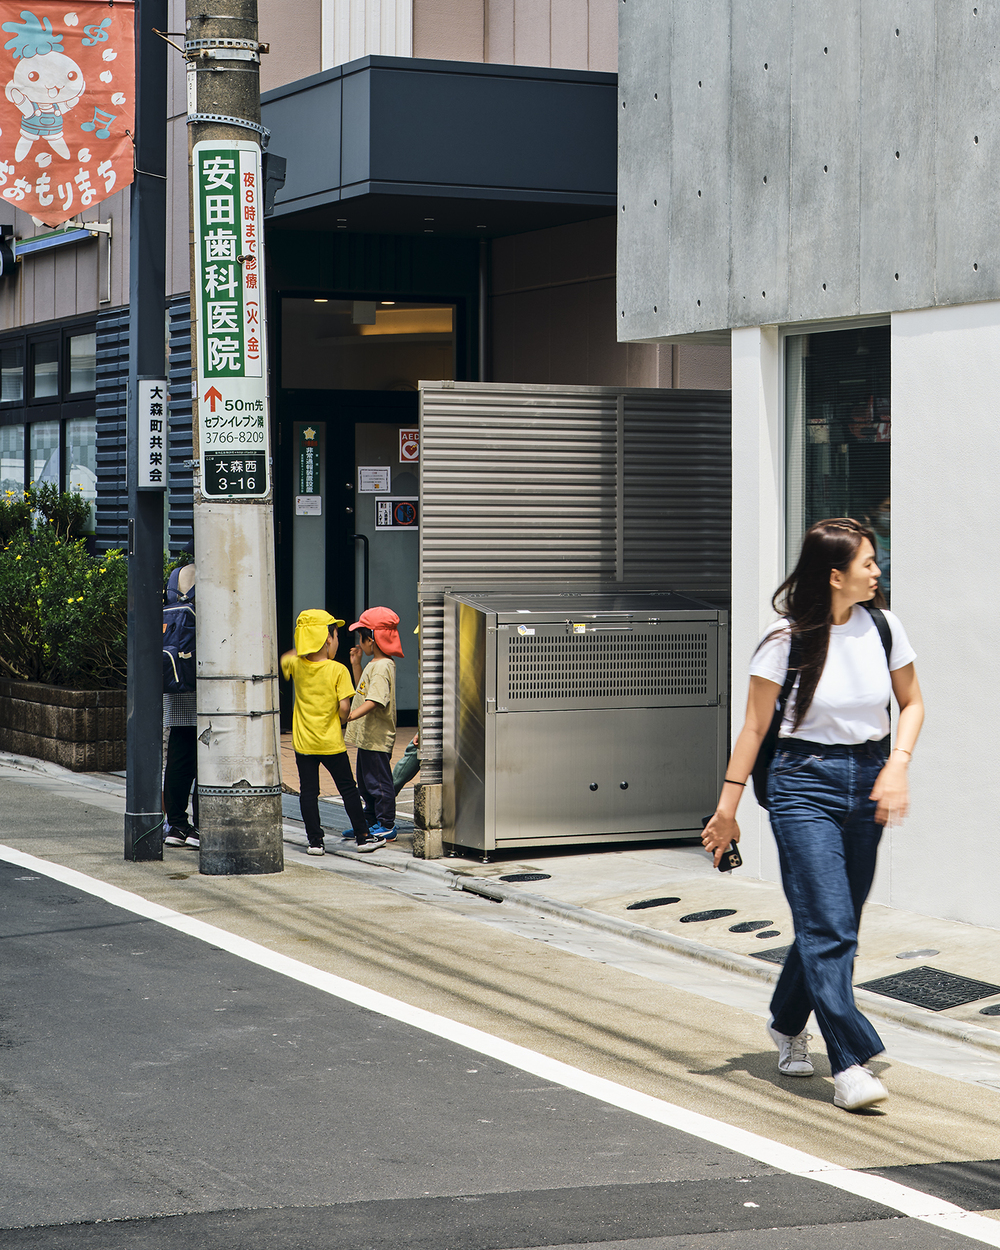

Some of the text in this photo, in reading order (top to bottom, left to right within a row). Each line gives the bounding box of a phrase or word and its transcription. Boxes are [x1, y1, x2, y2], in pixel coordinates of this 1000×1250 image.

[202, 156, 241, 371] 安田歯科医院
[224, 399, 263, 411] 50m先
[204, 415, 264, 428] セブンイレブン隣
[149, 386, 163, 483] 大森町共栄会
[206, 431, 264, 444] 3766-8209
[215, 460, 257, 473] 大森西
[218, 477, 256, 490] 3-16
